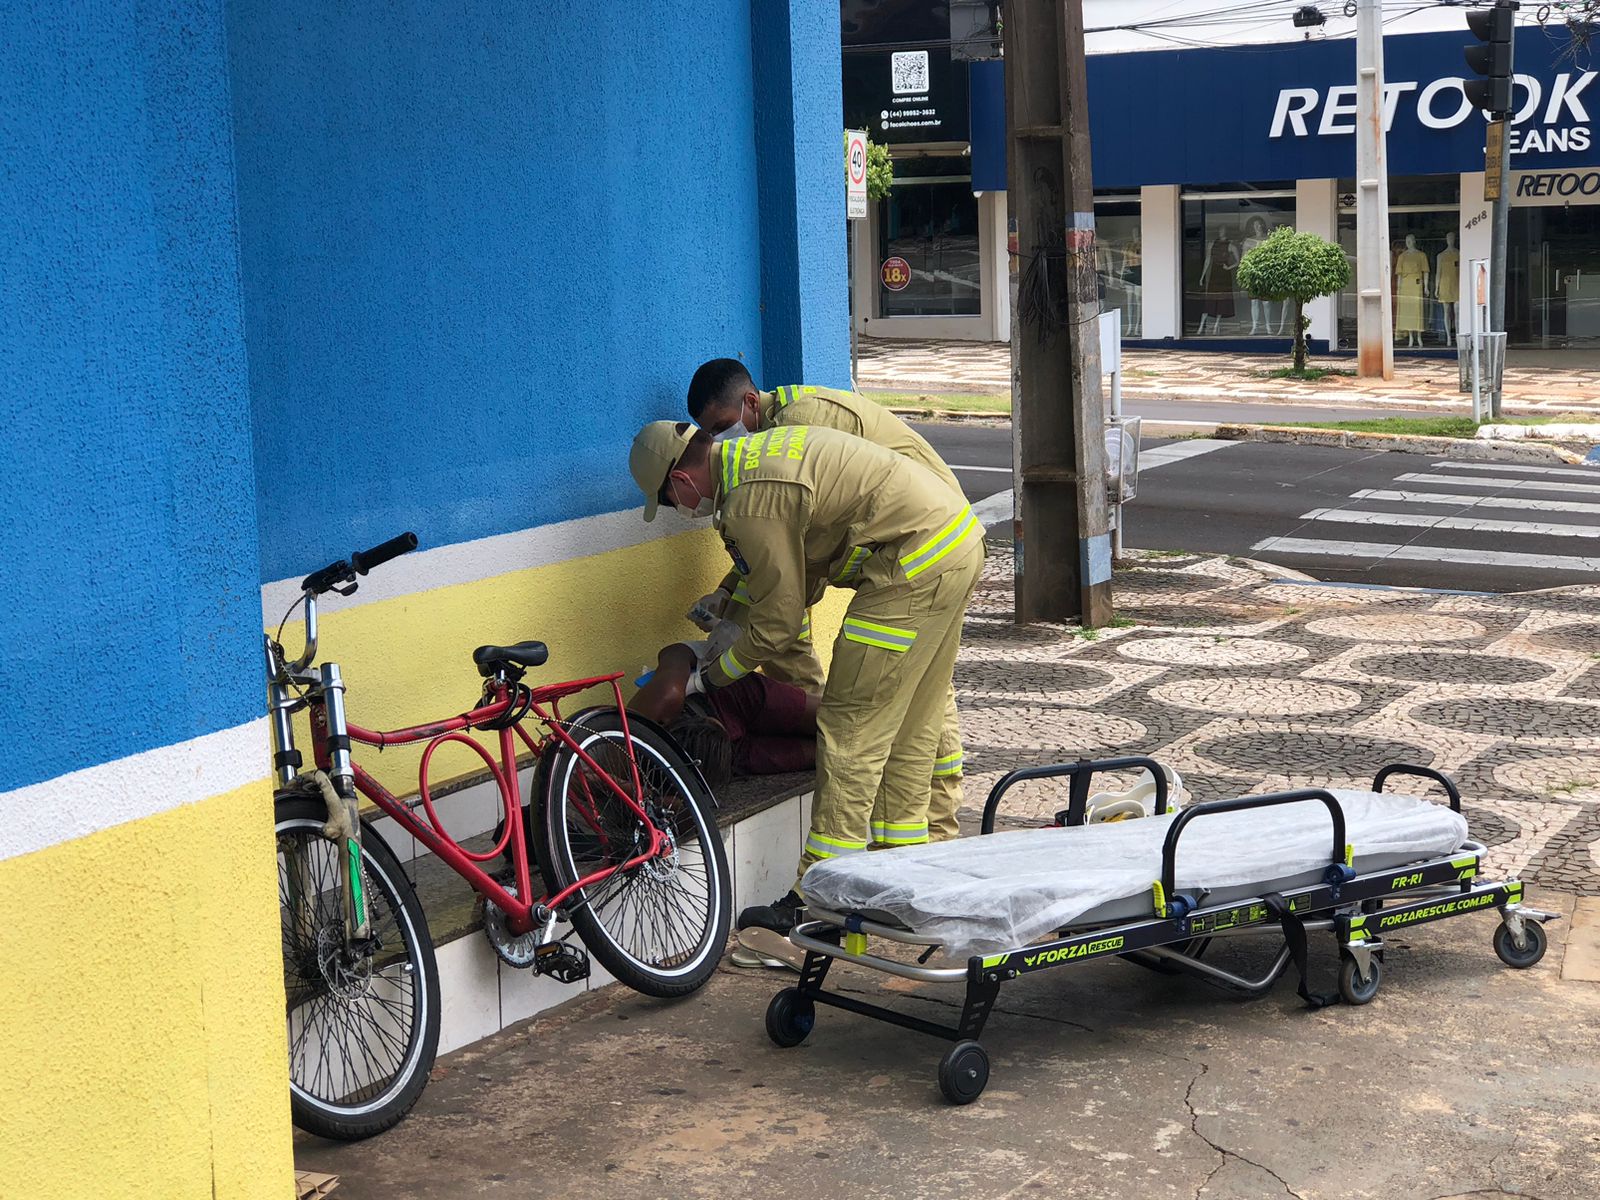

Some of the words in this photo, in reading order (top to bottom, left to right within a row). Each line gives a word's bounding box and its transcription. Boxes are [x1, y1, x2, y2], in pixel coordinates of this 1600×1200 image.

[1483, 127, 1591, 154] EANS
[852, 150, 862, 168] 40
[1380, 893, 1495, 928] FORZARESCUE.COM.BR
[1036, 942, 1088, 966] FORZA
[1089, 938, 1123, 954] RESCUE
